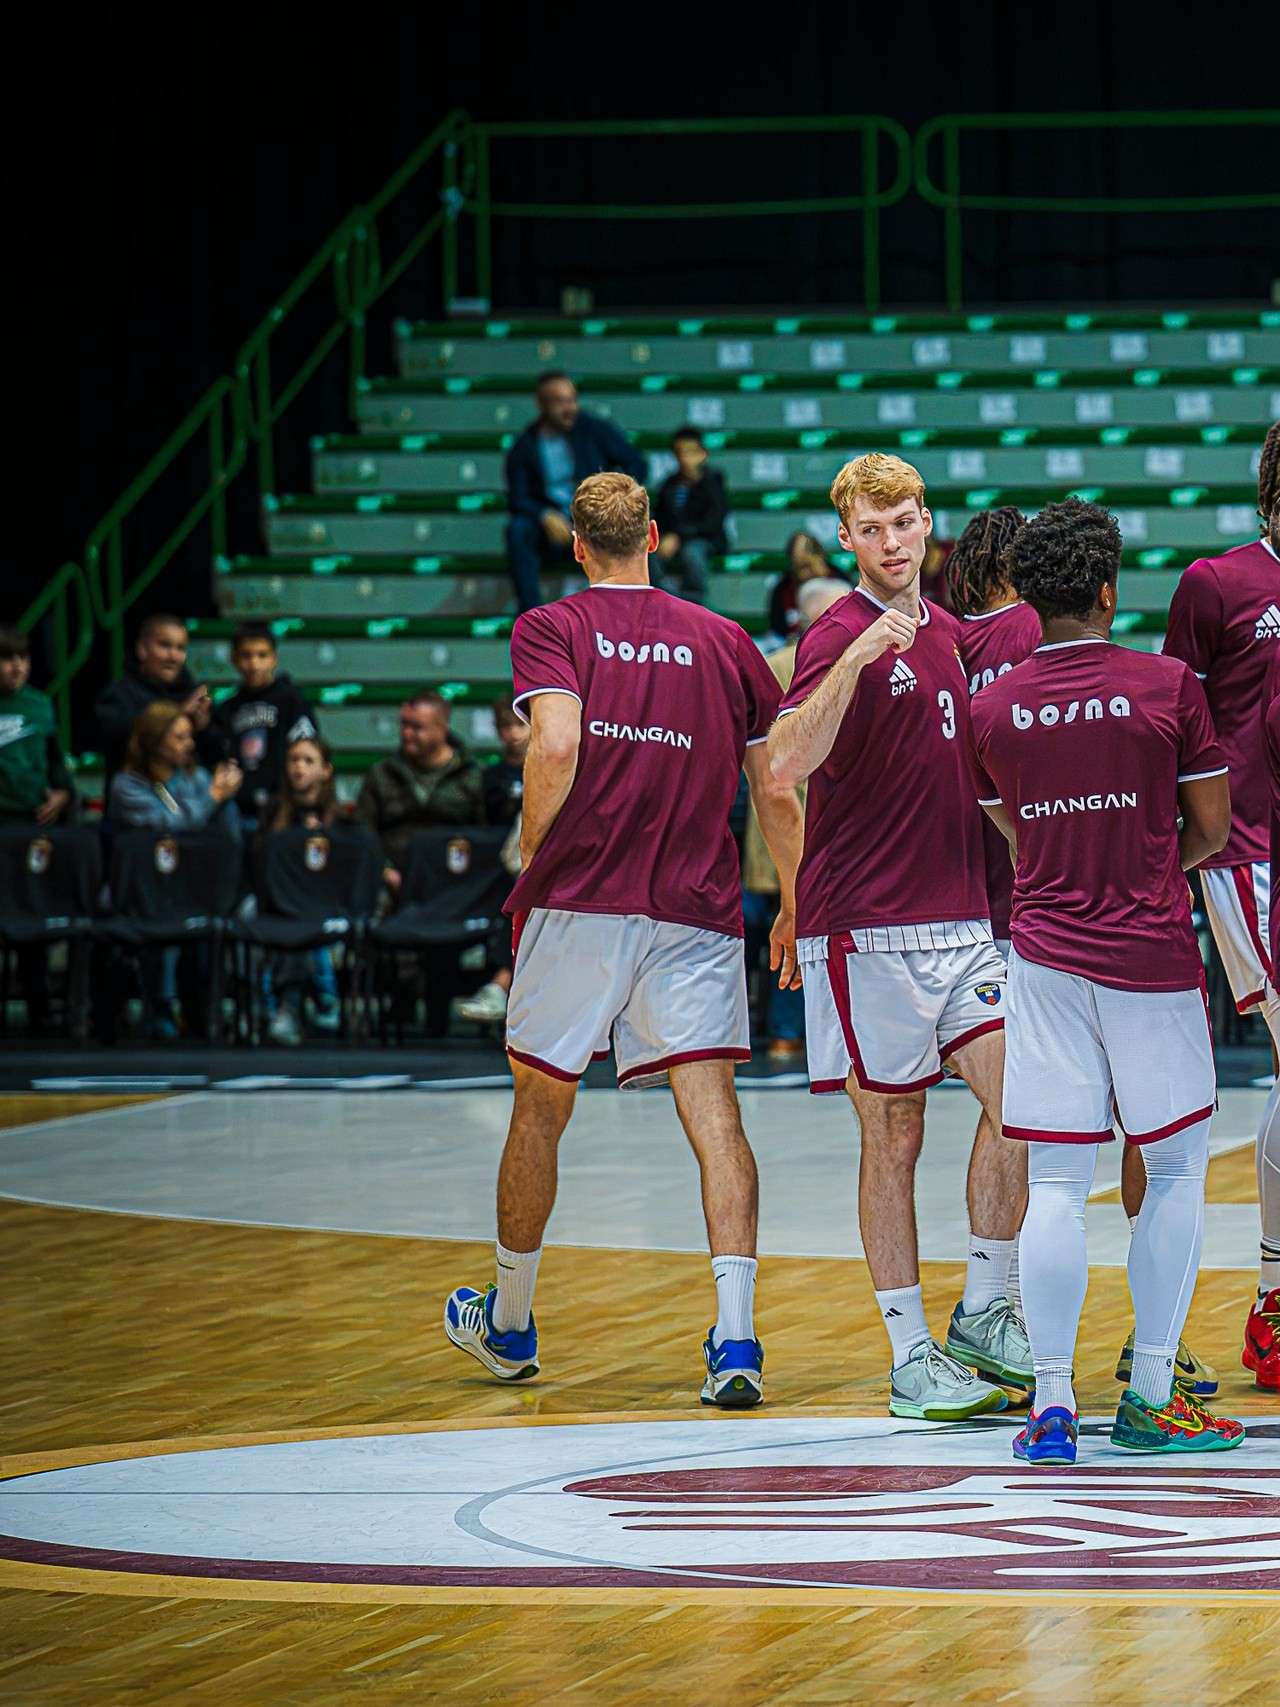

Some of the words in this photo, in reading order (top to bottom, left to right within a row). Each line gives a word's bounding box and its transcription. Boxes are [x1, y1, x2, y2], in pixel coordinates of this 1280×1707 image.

[595, 631, 693, 667] bosna
[937, 689, 956, 740] 3
[1011, 695, 1131, 730] bosna
[588, 720, 692, 750] CHANGAN
[1019, 792, 1137, 820] CHANGAN
